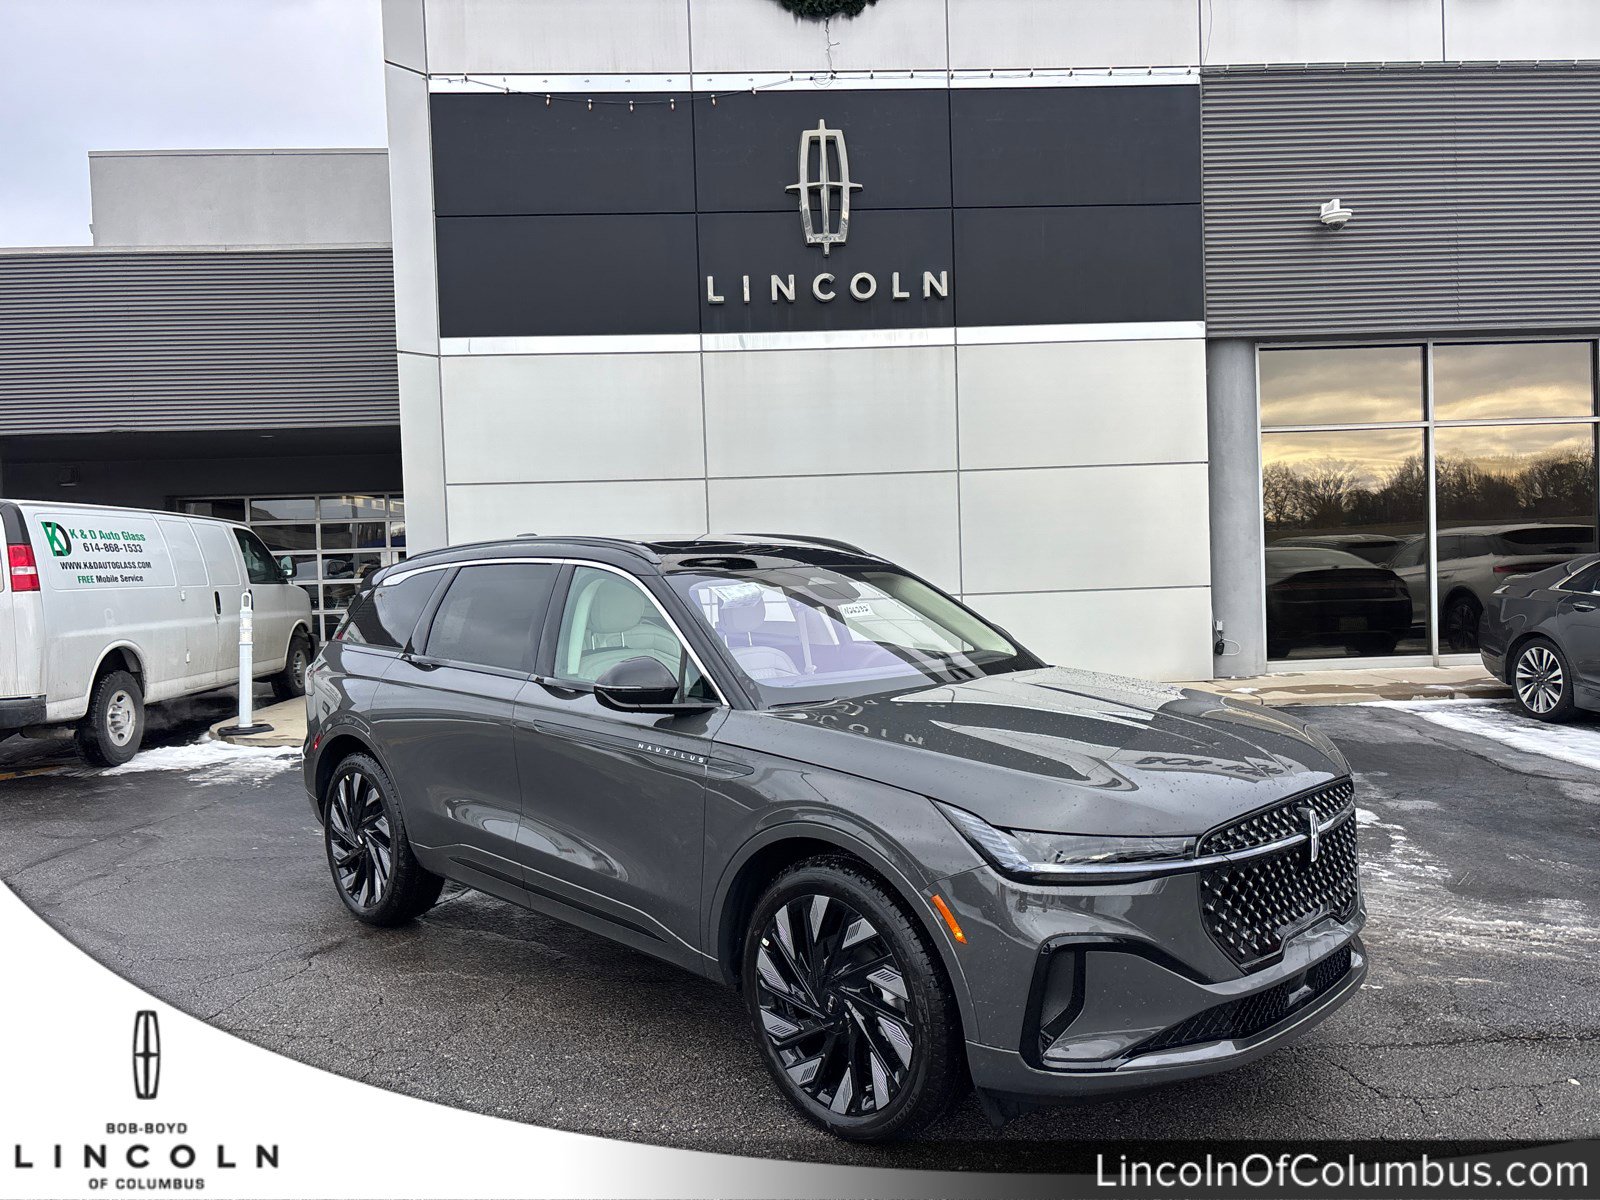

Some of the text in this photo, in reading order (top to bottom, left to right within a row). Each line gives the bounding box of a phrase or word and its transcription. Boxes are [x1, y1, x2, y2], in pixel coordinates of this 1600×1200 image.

[707, 271, 948, 304] LINCOLN
[69, 529, 146, 541] K & D Auto Glass
[83, 542, 143, 553] 614-868-1533
[60, 561, 152, 570] WWW.K&DAUTOGLASS.COM
[77, 574, 144, 583] FREE Mobile Service
[637, 743, 704, 763] NAUTILUS
